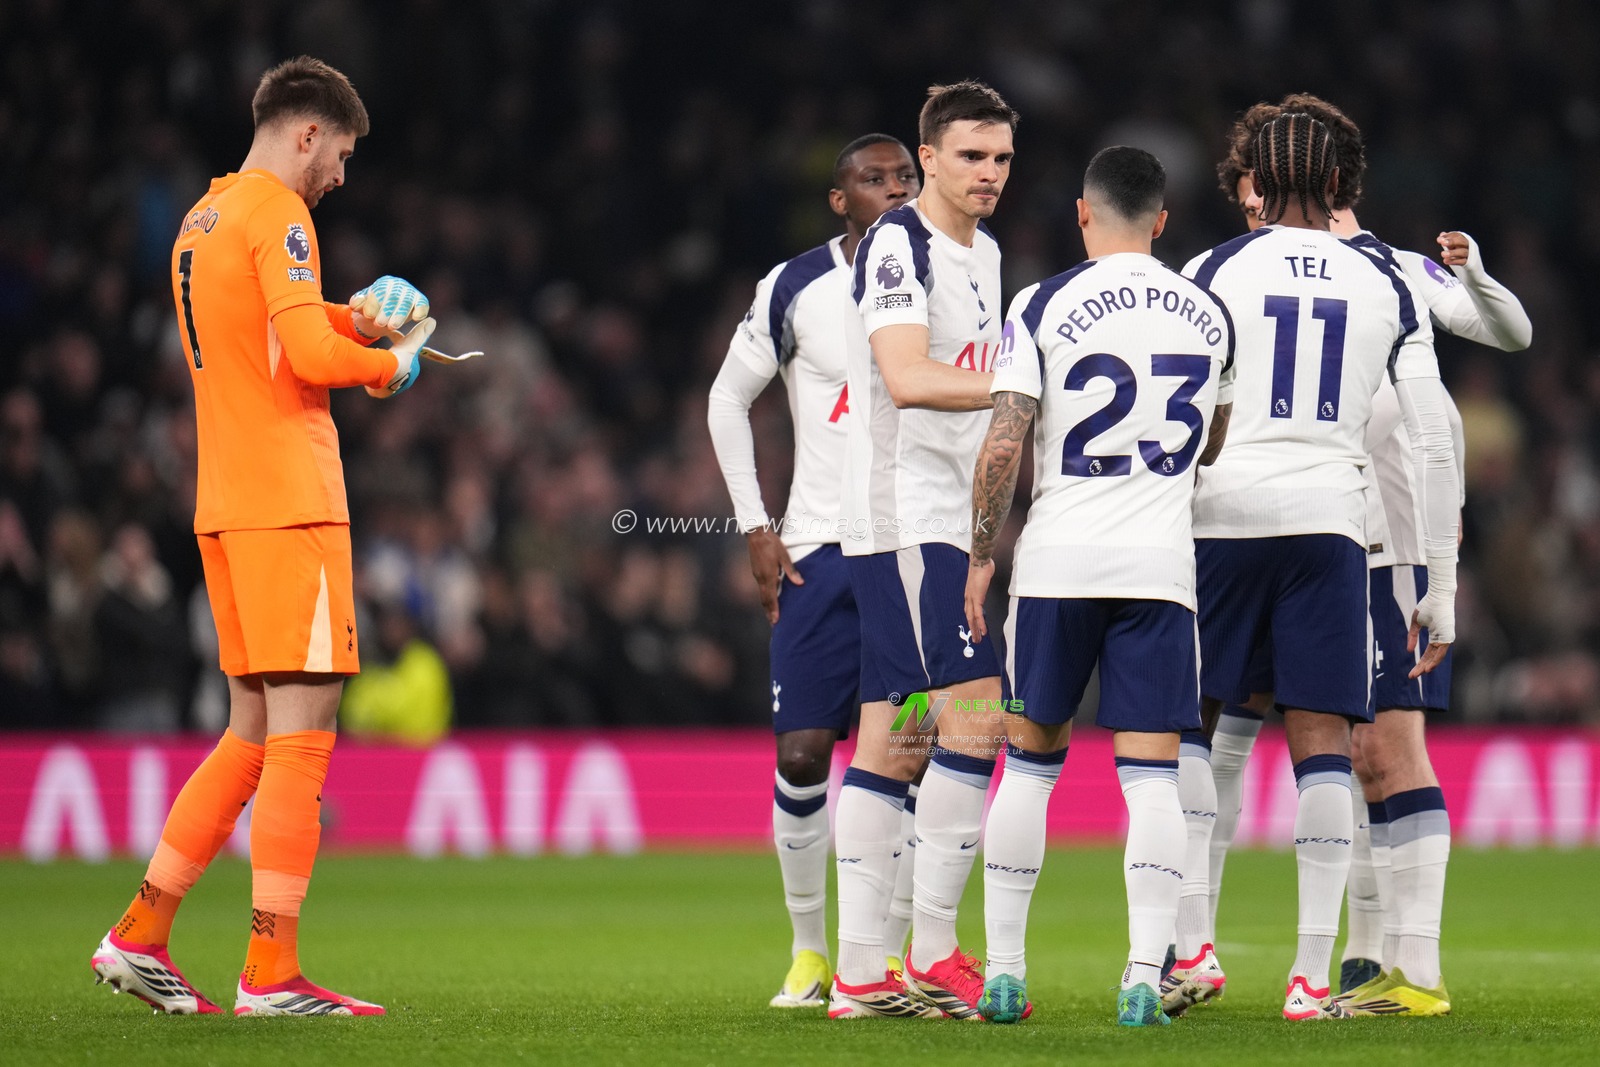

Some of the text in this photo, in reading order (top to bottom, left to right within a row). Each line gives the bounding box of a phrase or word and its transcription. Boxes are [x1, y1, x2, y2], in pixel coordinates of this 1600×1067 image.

[1285, 257, 1332, 280] TEL
[178, 249, 203, 370] 1
[887, 295, 909, 303] room
[888, 301, 913, 309] racism
[1057, 287, 1222, 347] PEDRO PORRO
[1264, 295, 1348, 422] 11
[1061, 352, 1211, 477] 23
[406, 742, 644, 859] AIA
[1294, 837, 1352, 846] SPURS
[985, 862, 1040, 875] SPURS
[1128, 862, 1184, 880] SPURS
